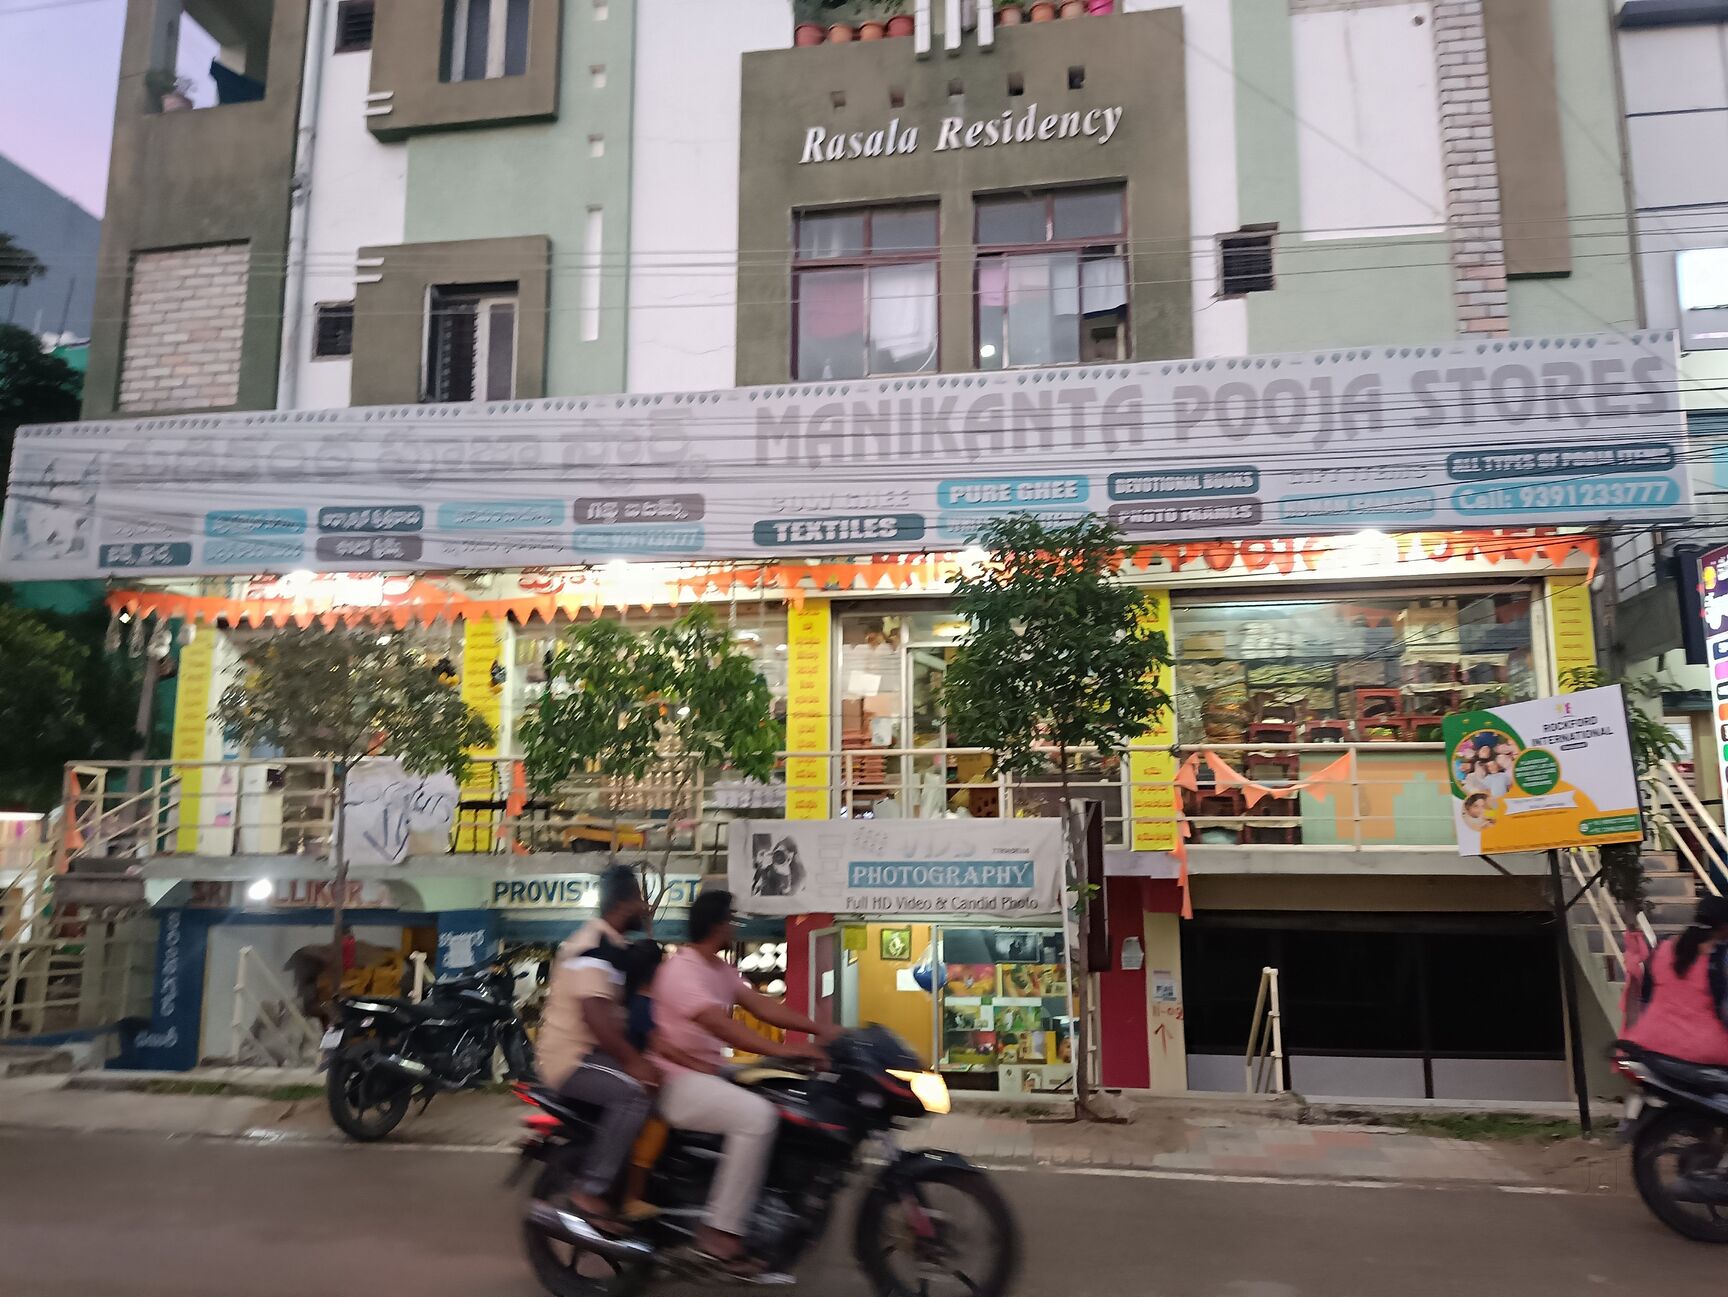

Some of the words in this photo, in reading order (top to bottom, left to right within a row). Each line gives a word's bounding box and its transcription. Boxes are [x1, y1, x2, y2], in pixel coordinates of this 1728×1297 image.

[798, 118, 919, 166] Rasala
[933, 102, 1124, 154] Residency
[755, 384, 1145, 470] MANIKANTA
[1171, 372, 1382, 451] POOJA
[1408, 355, 1668, 431] STORES
[949, 483, 1012, 504] PURE
[1016, 479, 1079, 502] GHEE
[1518, 479, 1670, 509] 9391233777
[773, 516, 899, 543] TEXTILES
[1531, 726, 1614, 746] INTERNATIONAL
[1543, 716, 1598, 732] ROCKFORD
[852, 862, 1031, 886] PHOTOGRAPHY
[846, 896, 868, 909] Full
[872, 896, 892, 910] HD
[893, 895, 932, 910] Video
[950, 895, 997, 911] Candid
[1001, 896, 1039, 910] Photo
